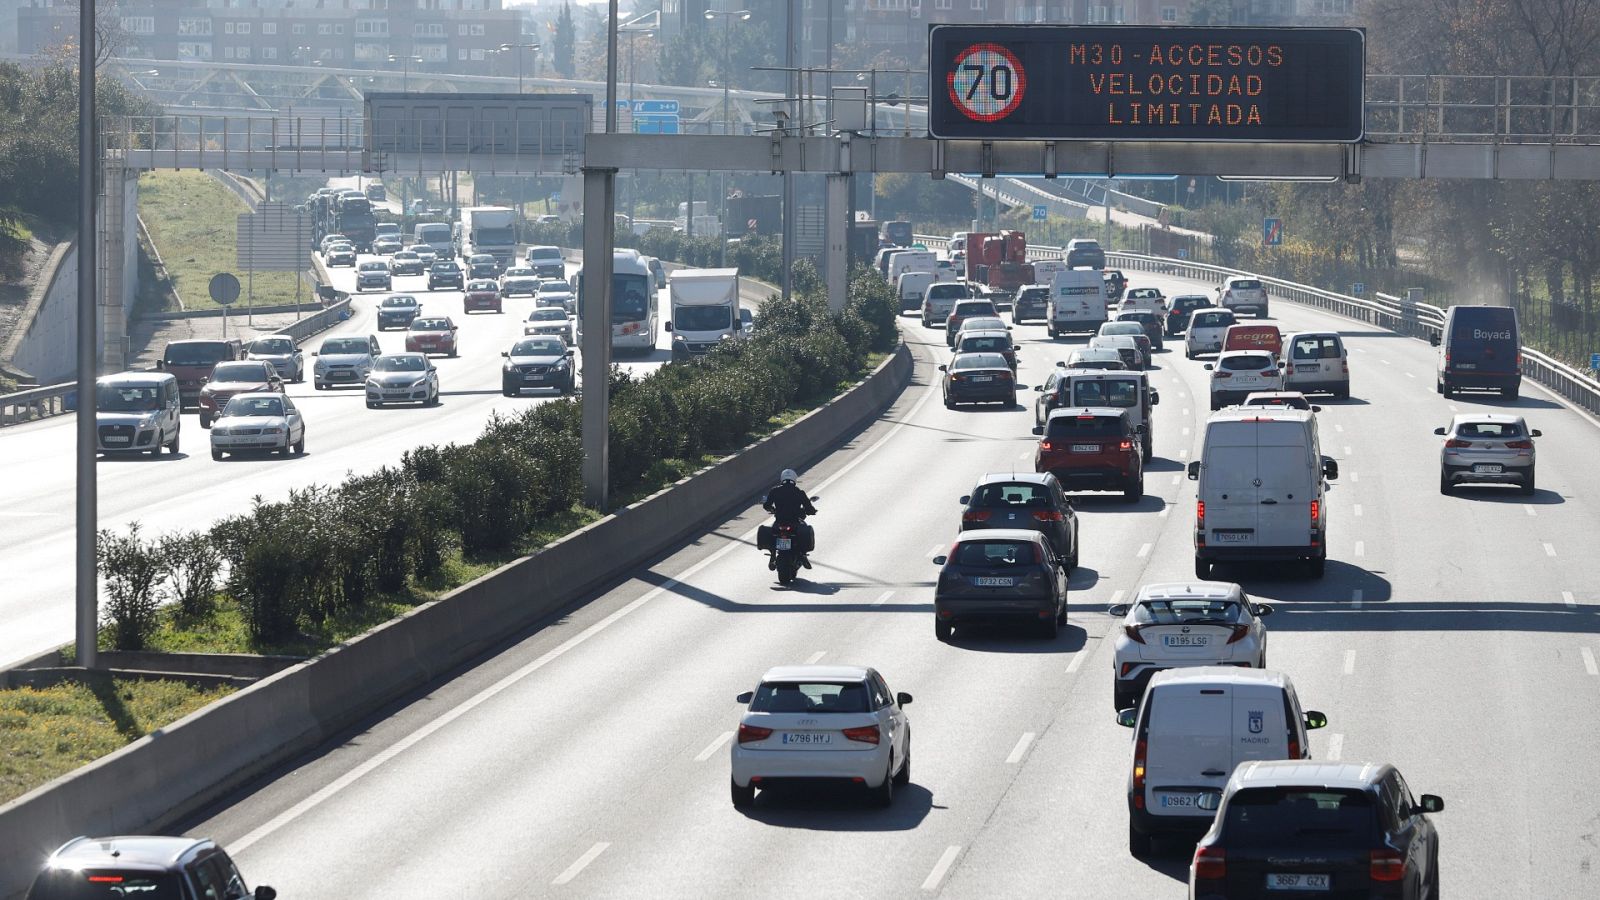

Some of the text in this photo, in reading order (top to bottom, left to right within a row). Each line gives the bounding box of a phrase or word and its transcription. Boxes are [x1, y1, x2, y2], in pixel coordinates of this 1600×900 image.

[1070, 43, 1284, 66] M30-ACCESOS
[963, 64, 1012, 101] 70
[1089, 73, 1263, 96] VELOCIDAD
[1109, 103, 1262, 125] LIMITADA
[1035, 208, 1046, 216] 70
[1234, 333, 1274, 341] scgm
[1474, 329, 1511, 341] Boyacá
[1170, 637, 1207, 645] 8195 LSG
[789, 734, 831, 743] 4796 HYJ
[1240, 737, 1270, 745] MADRID
[1167, 796, 1192, 806] 0962
[1275, 875, 1327, 887] 3667 GZX
